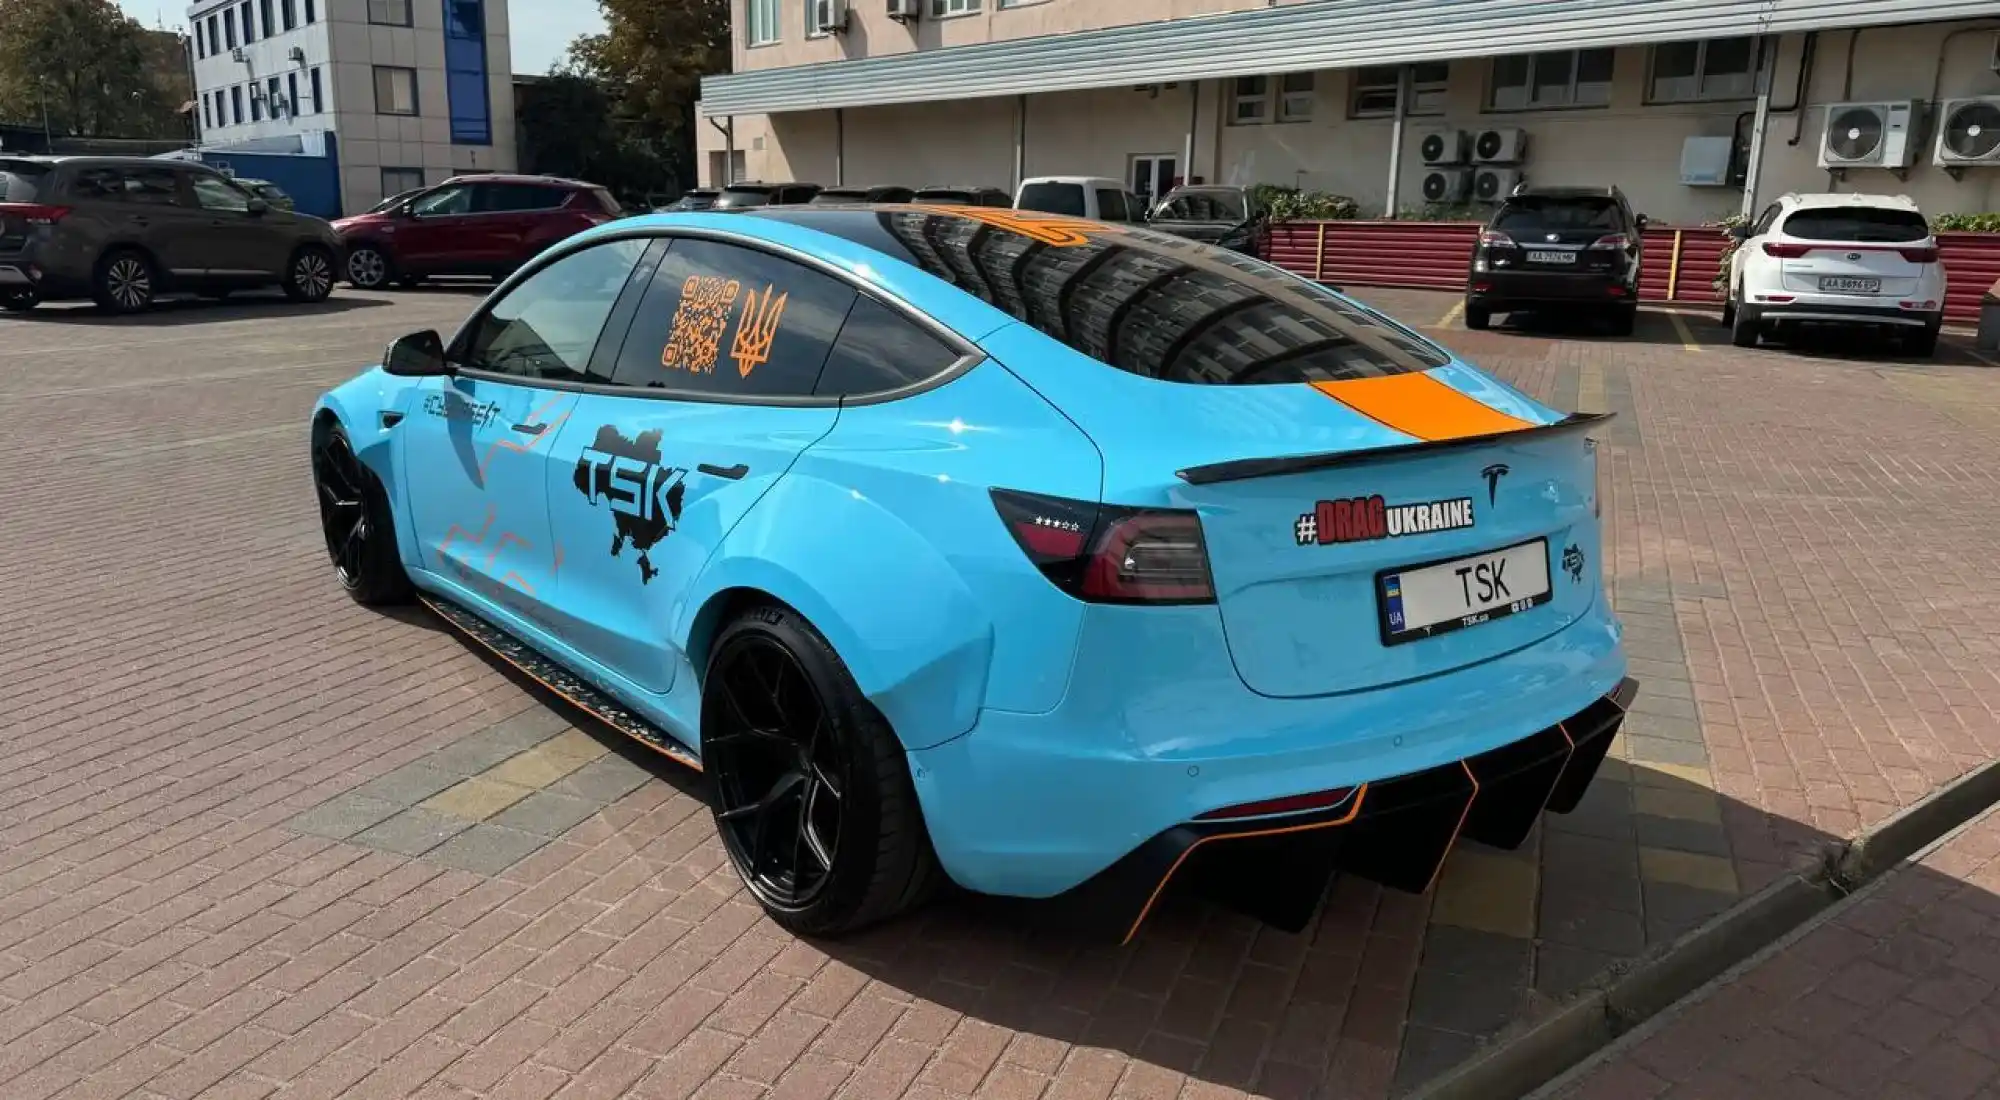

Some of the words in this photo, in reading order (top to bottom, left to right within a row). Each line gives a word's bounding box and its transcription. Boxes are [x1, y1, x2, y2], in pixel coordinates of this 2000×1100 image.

[581, 446, 688, 531] TSK
[1455, 558, 1510, 608] TSK
[1388, 611, 1403, 625] UA
